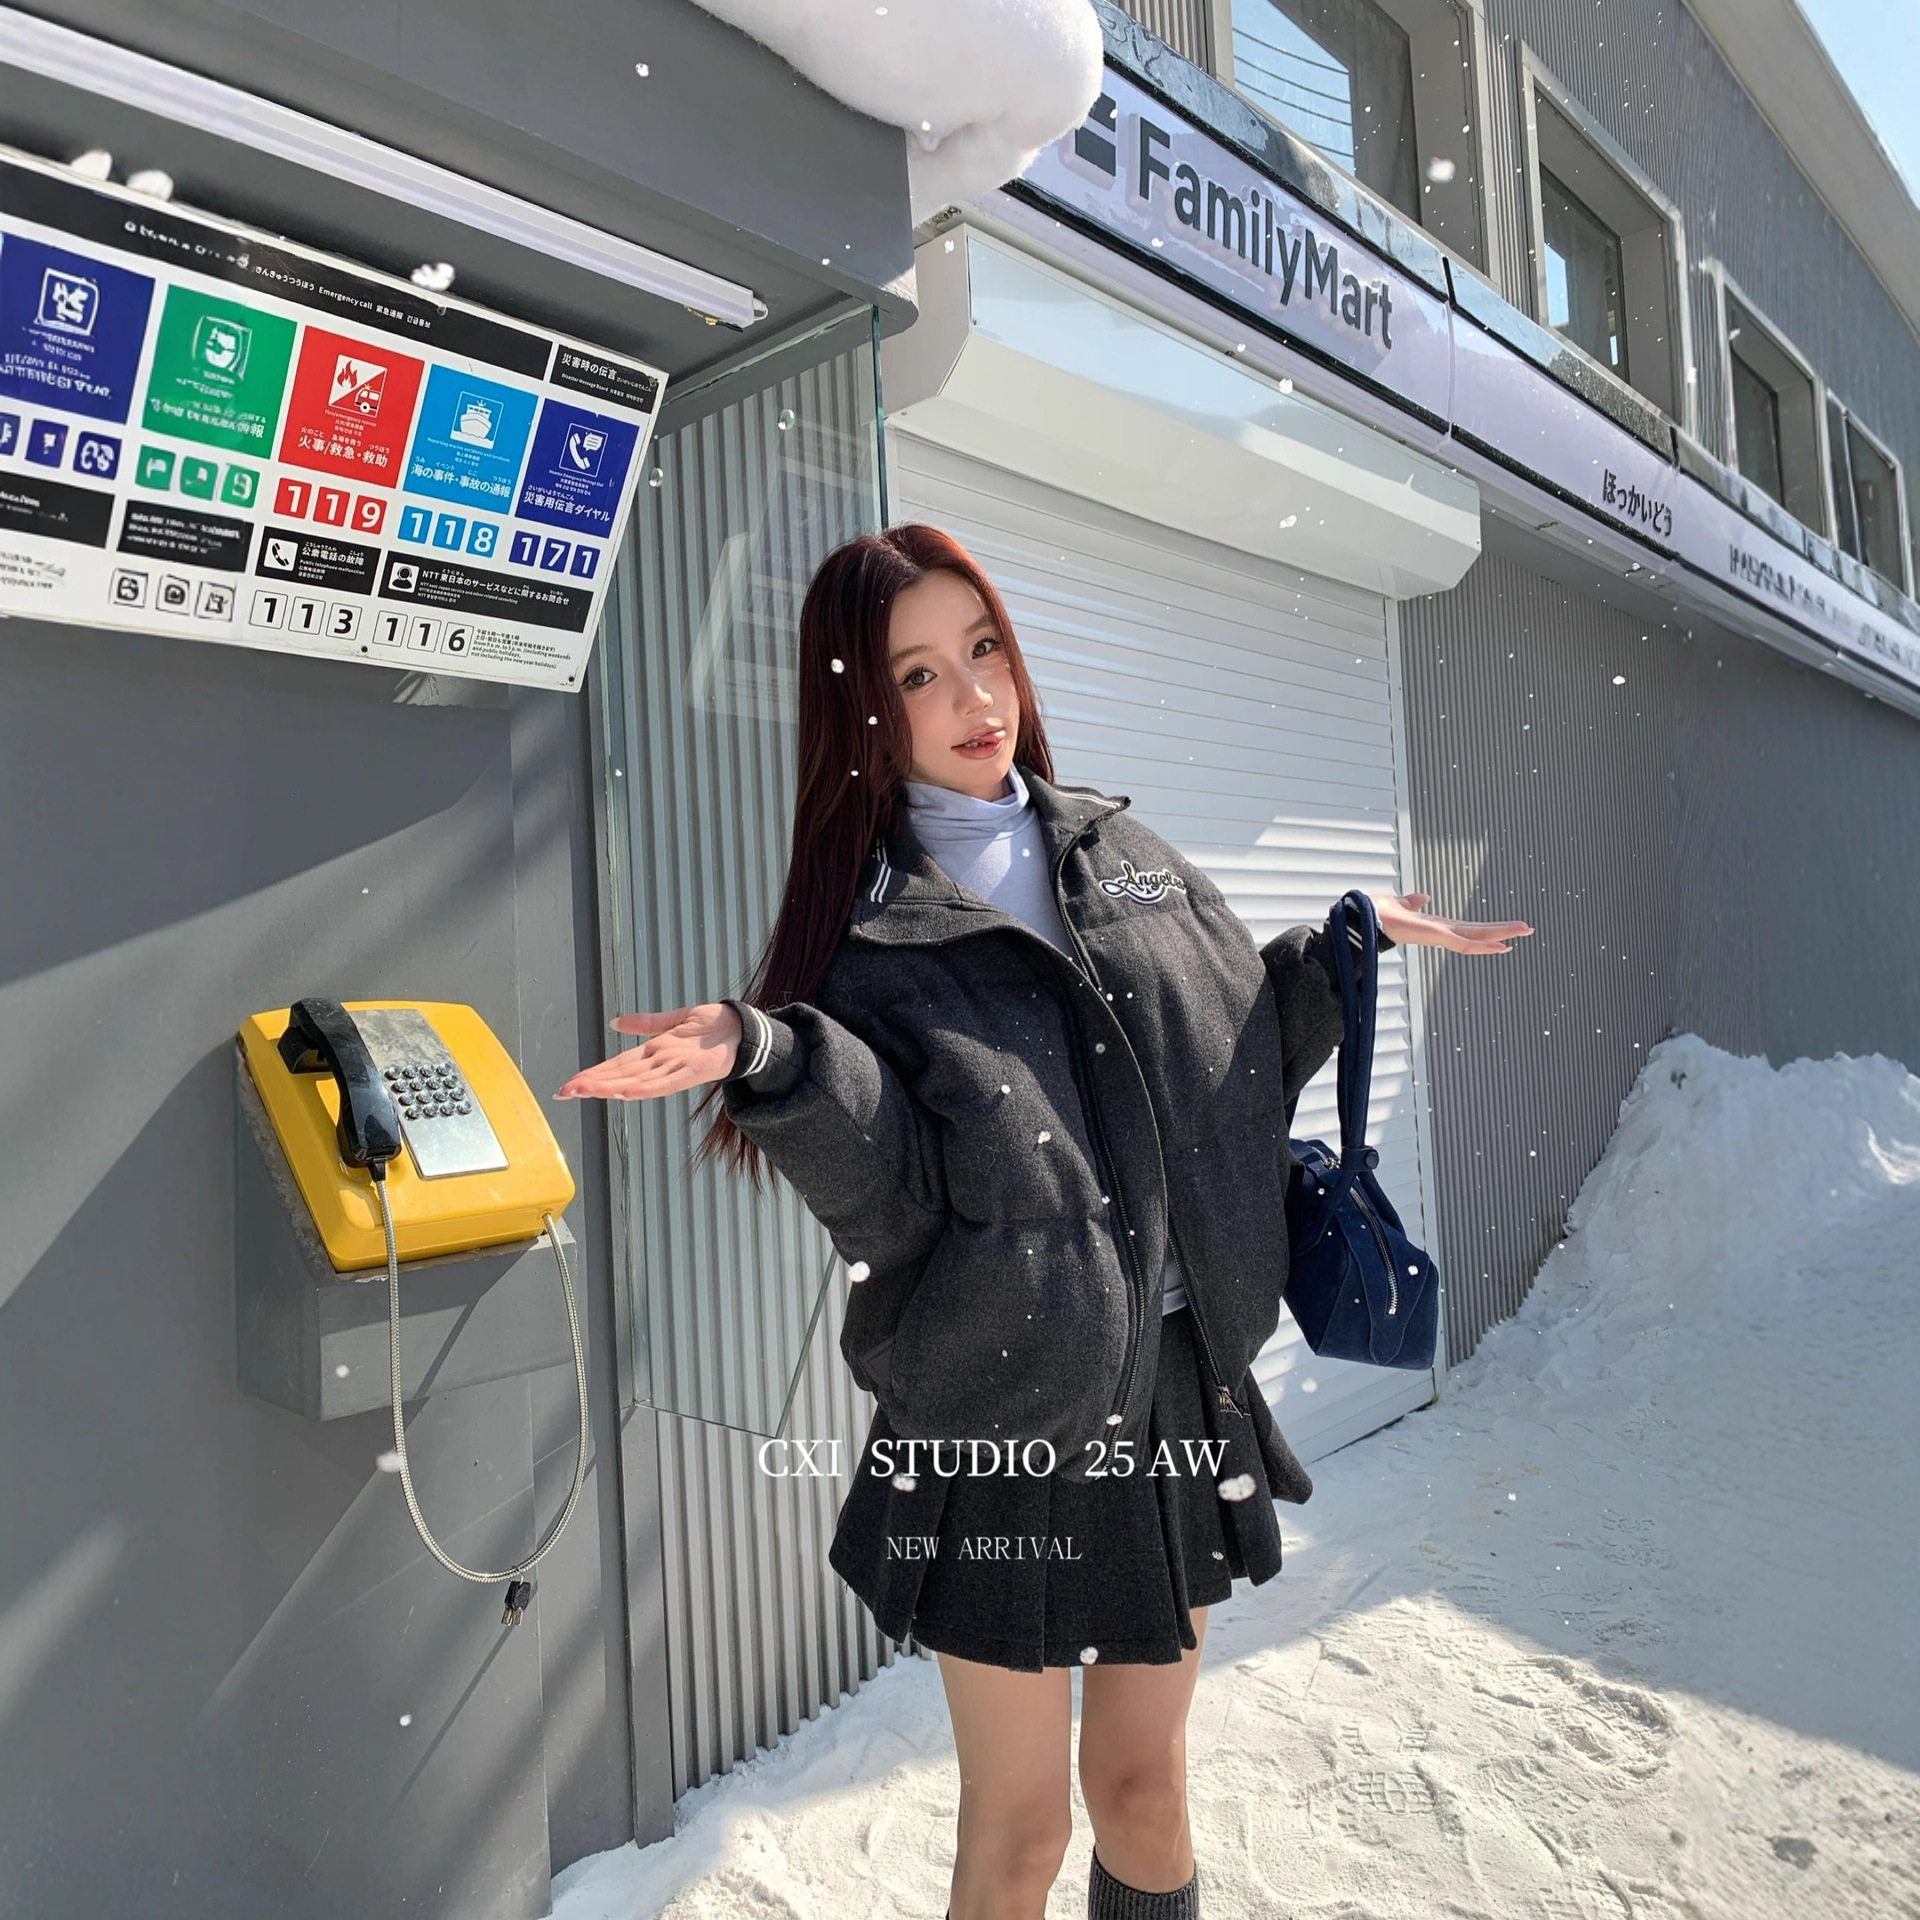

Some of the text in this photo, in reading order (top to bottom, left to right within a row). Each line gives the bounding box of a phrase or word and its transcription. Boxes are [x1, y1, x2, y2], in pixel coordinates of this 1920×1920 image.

[1140, 117, 1392, 350] FamilyMart
[318, 286, 373, 311] Emergency call
[561, 353, 617, 380] 災害時の伝言
[411, 463, 511, 498] 海の事件・事故の通報
[523, 490, 610, 522] 災害用伝言ダイヤル
[302, 546, 364, 566] 公衆電話の故障
[422, 570, 440, 580] NTT
